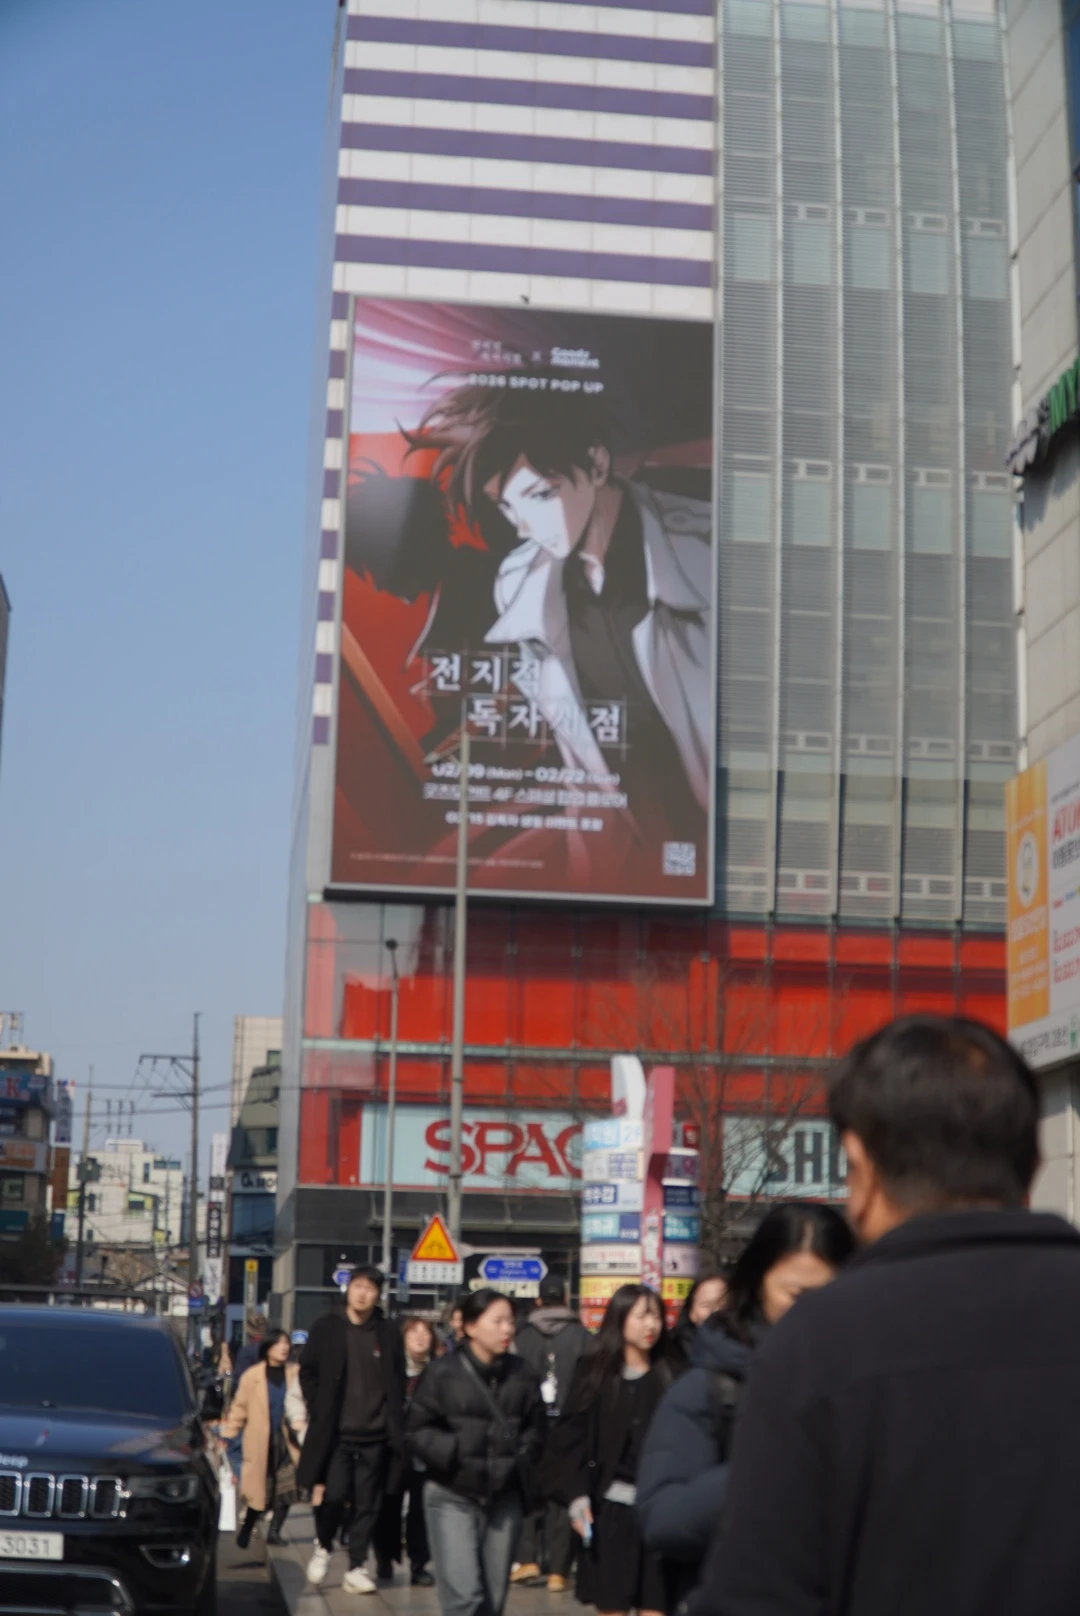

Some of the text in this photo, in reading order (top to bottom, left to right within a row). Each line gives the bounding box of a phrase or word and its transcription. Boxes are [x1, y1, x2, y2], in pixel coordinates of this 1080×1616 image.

[509, 376, 548, 389] SPOT
[550, 378, 581, 392] POP
[583, 381, 604, 394] UP
